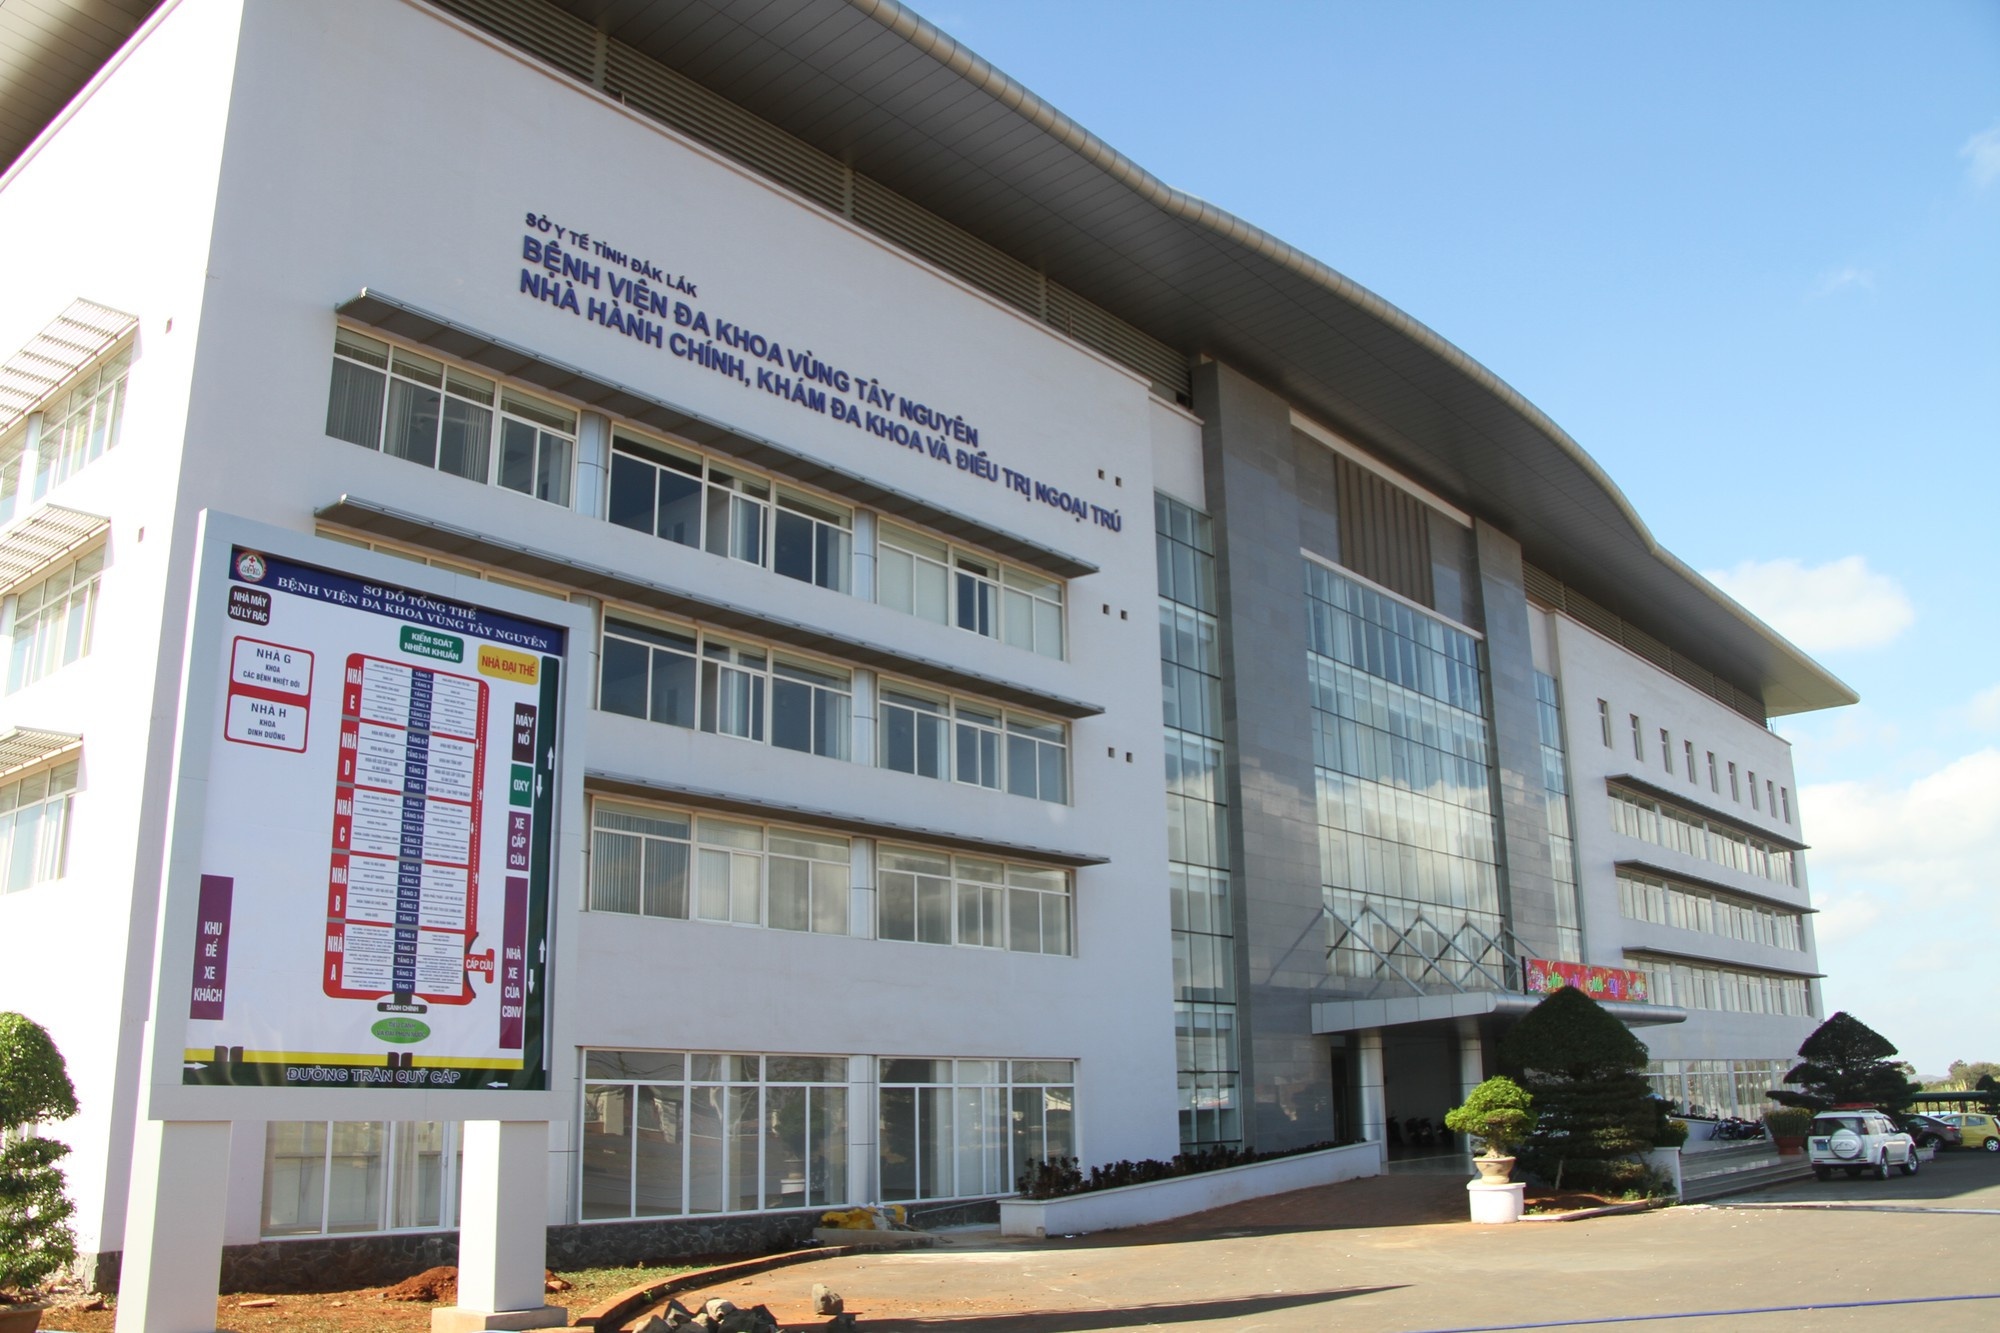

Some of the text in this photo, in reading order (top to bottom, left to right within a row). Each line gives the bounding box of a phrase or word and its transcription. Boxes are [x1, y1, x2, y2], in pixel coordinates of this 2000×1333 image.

[526, 212, 552, 234] SỞ
[554, 224, 566, 240] Y
[569, 231, 590, 251] TẾ
[593, 240, 628, 268] TỈNH
[523, 235, 979, 448] BỆNH VIỆN ĐA KHOA VÙNG TÂY NGUYÊN
[520, 268, 1122, 533] NHÀ HÀNH CHÍNH, KHÁM ĐA KHOA VÀ ĐIỀU TRỊ NGOẠI TRÚ
[233, 590, 268, 608] NHÀ MÁY
[363, 585, 478, 621] SƠ ĐỒ TỔNG THỂ
[229, 604, 268, 623] XỬ LÝ RÁC
[277, 576, 548, 649] BỆNH VIỆN ĐA KHOA VÙNG TÂY NGUYÊN
[411, 631, 454, 648] KIỂM SOÁT
[256, 648, 292, 664] NHÀ G
[404, 641, 460, 661] NHIỄM KHUẨN
[265, 664, 281, 673] KHOA
[481, 654, 537, 677] NHÀ ĐẠI THỂ
[242, 669, 255, 679] CÁC
[256, 671, 272, 682] BỆNH
[346, 666, 362, 685] NHÀ
[251, 702, 287, 718] NHÀ H
[349, 694, 356, 710] E
[259, 719, 276, 728] KHOA
[515, 713, 534, 728] MÁY
[247, 728, 263, 737] DINH
[341, 731, 357, 749] NHÀ
[517, 730, 530, 746] NỔ
[344, 760, 351, 776] D
[513, 779, 530, 792] OXY
[336, 797, 352, 817] NHÀ
[514, 817, 525, 829] XE
[339, 826, 346, 842] C
[511, 833, 526, 848] CẤP
[331, 865, 347, 885] NHÀ
[334, 895, 341, 911] B
[204, 921, 222, 936] KHU
[205, 939, 219, 957] ĐỂ
[327, 933, 343, 953] NHÀ
[506, 946, 521, 960] NHÀ
[466, 957, 479, 969] CẤP
[204, 966, 216, 980] XE
[330, 964, 336, 981] A
[508, 966, 518, 979] XE
[193, 985, 222, 1002] KHÁCH
[505, 982, 520, 998] CỦA
[502, 1005, 522, 1018] CBNV
[287, 1066, 348, 1082] ĐƯỜNG
[396, 1068, 428, 1084] QUÝ
